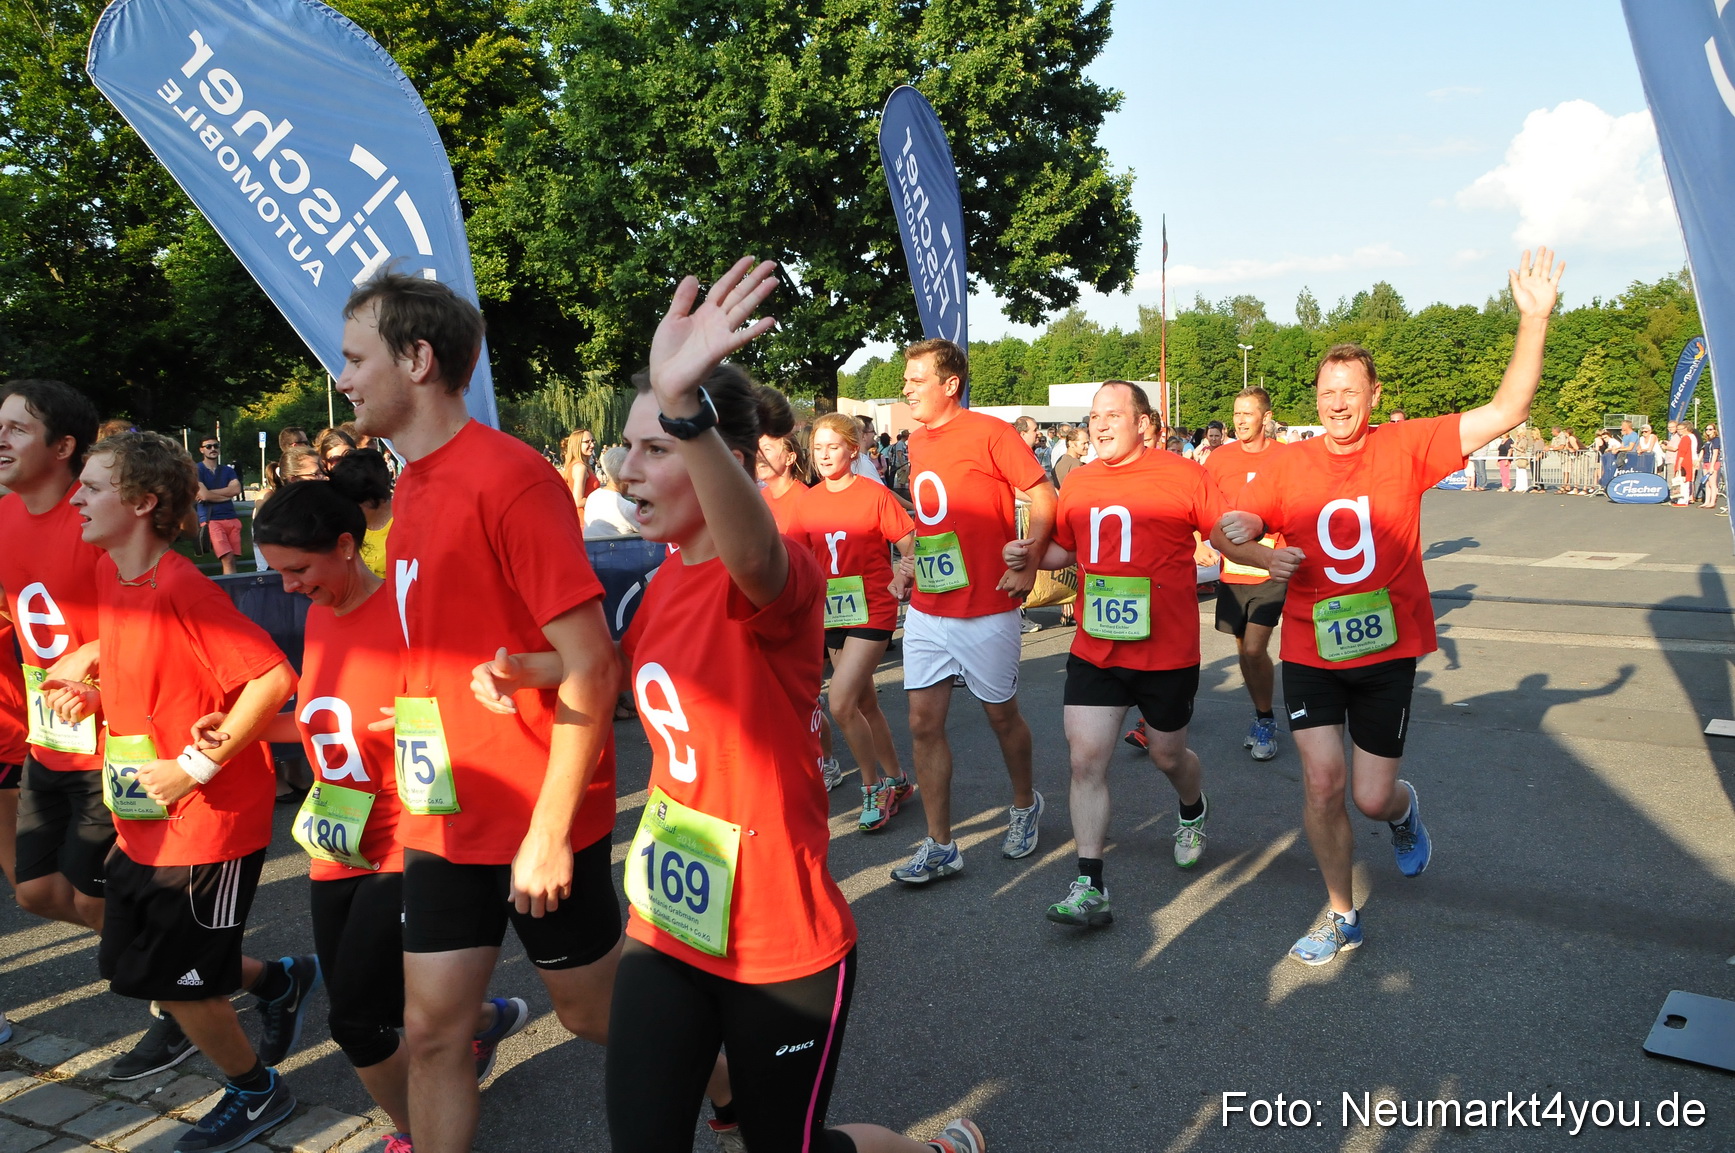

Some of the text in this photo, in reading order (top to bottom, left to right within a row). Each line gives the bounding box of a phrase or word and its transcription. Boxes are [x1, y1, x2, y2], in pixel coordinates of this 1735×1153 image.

[1622, 485, 1663, 494] Fischer
[825, 530, 847, 575] r
[1089, 504, 1132, 564] n
[1316, 495, 1376, 585] g
[916, 553, 955, 579] 176
[17, 581, 69, 660] e
[395, 558, 419, 649] r
[825, 594, 857, 616] 171
[1092, 597, 1139, 625] 165
[1327, 614, 1384, 646] 188
[299, 696, 371, 782] a
[635, 661, 697, 784] e
[302, 815, 352, 857] 180
[640, 840, 710, 915] 169
[648, 893, 668, 911] Melanie
[668, 905, 700, 925] Grabmann
[788, 1039, 815, 1053] asics
